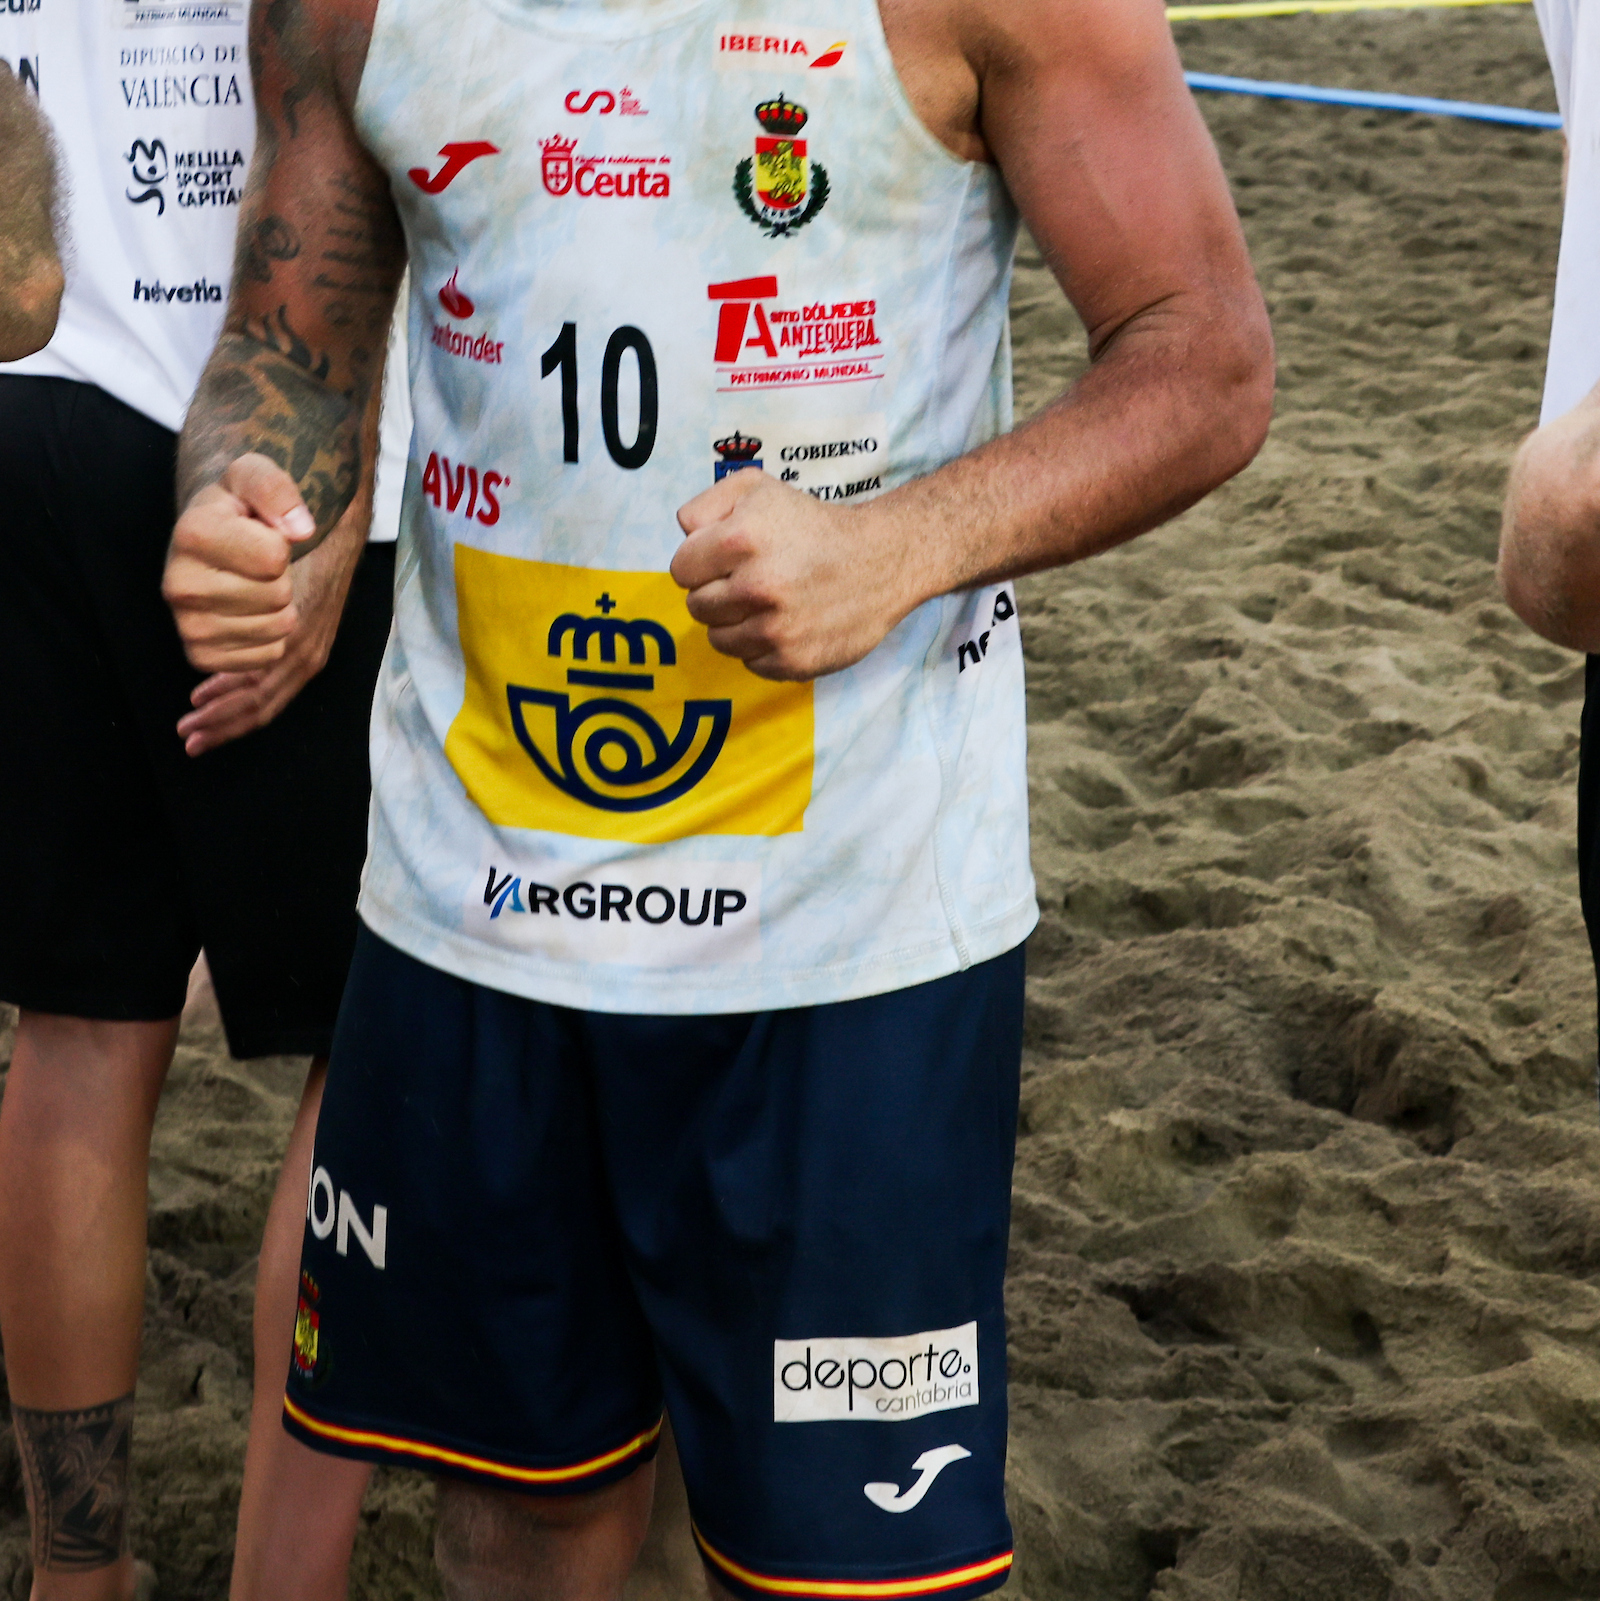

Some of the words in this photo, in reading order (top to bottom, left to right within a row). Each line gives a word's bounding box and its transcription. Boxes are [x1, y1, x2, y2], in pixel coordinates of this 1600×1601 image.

[215, 45, 242, 64] DE
[719, 33, 809, 57] IBERIA
[574, 164, 670, 198] Ceuta
[541, 321, 659, 471] 10
[779, 437, 878, 462] GOBIERNO
[779, 467, 800, 482] de
[808, 475, 882, 501] NTABRIA
[483, 865, 747, 927] VARGROUP
[309, 1164, 388, 1271] ON
[875, 1381, 972, 1414] cantabria
